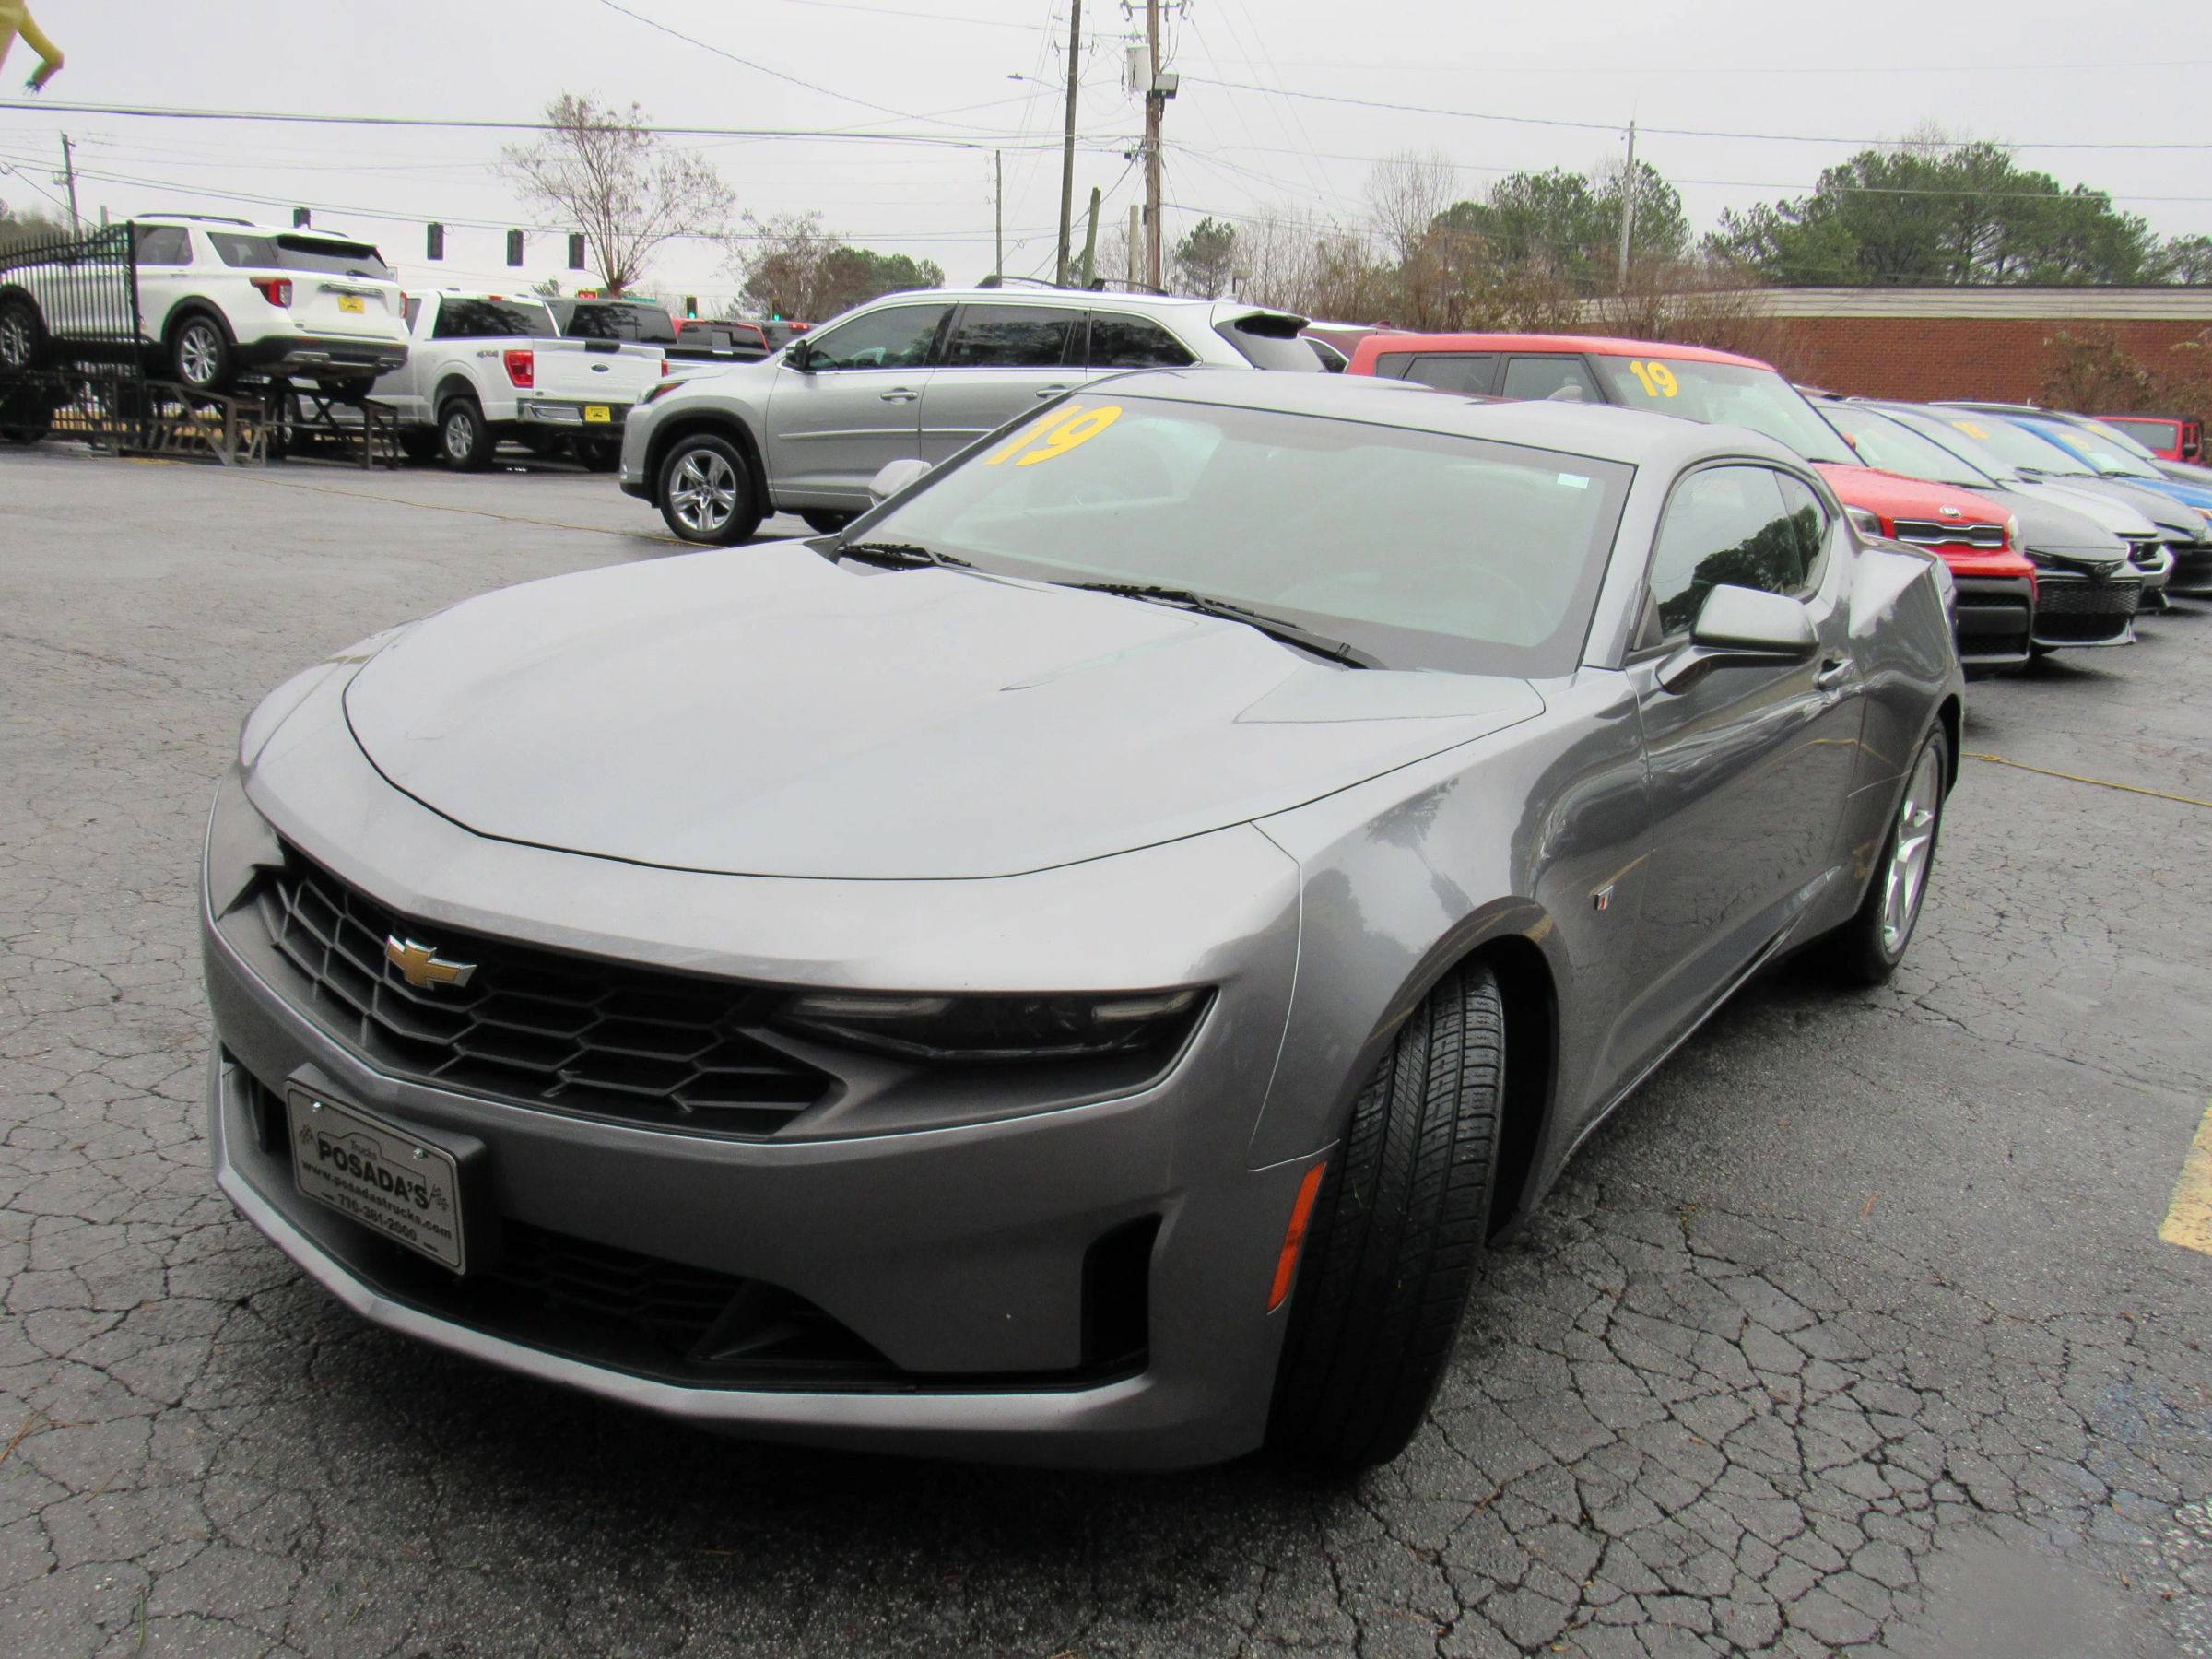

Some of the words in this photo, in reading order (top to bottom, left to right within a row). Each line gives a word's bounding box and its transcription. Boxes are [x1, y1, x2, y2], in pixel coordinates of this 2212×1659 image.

[1630, 360, 1678, 398] 19
[983, 406, 1123, 466] 19
[317, 1137, 429, 1210] POSADA'S
